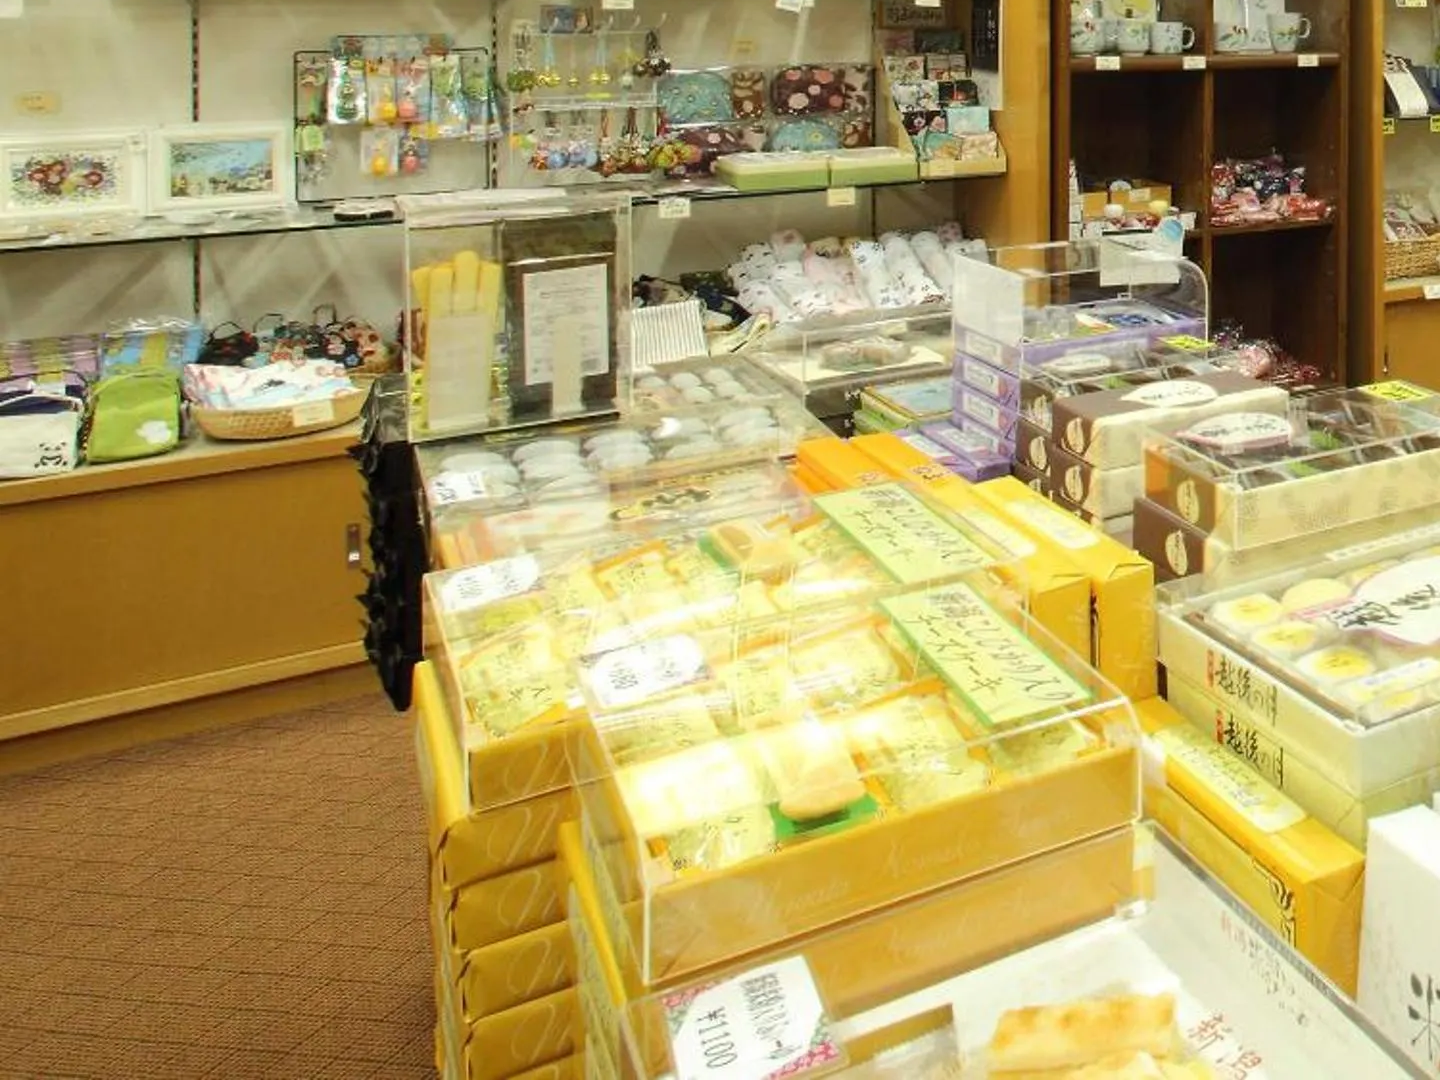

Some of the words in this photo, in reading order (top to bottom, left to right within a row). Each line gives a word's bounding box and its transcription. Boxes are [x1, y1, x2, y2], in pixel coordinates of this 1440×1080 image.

[903, 613, 1003, 692] チーズケーキ
[1215, 653, 1278, 728] 越後の月
[1223, 712, 1285, 789] 越後の月
[696, 1005, 738, 1070] ¥1100
